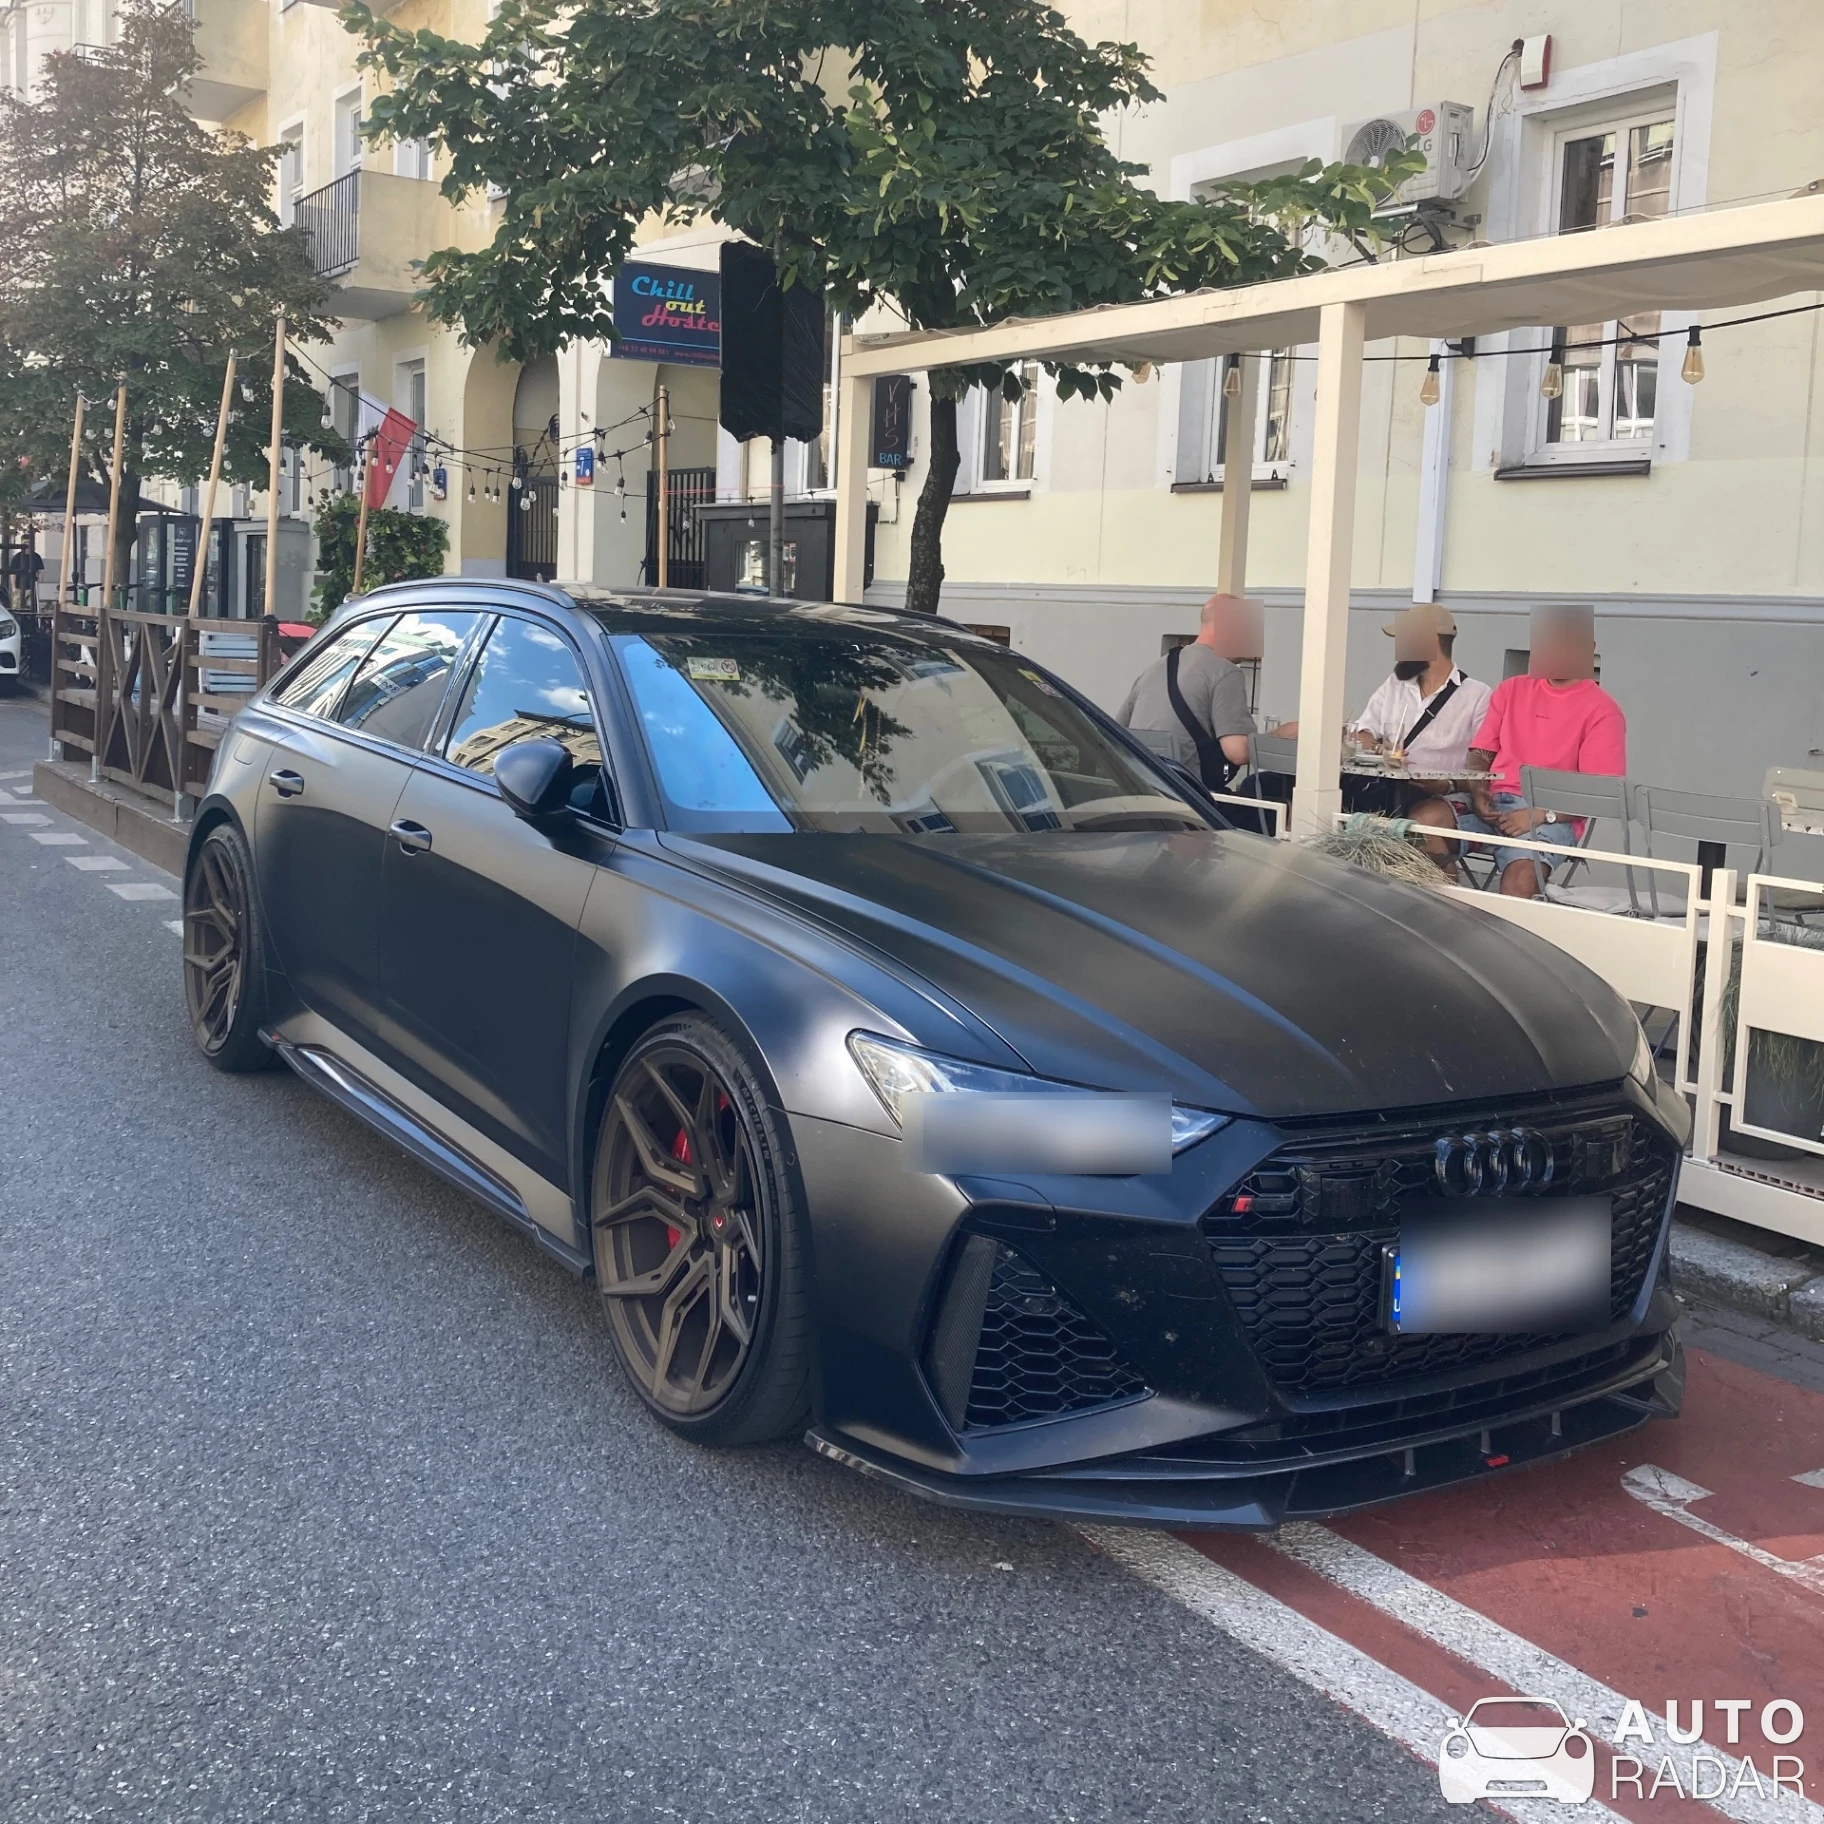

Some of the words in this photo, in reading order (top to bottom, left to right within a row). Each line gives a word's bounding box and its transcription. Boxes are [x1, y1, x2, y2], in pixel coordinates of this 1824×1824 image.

[632, 276, 694, 301] Chill
[641, 304, 720, 332] Hoste
[665, 299, 707, 315] out
[879, 452, 902, 465] BAR
[741, 1086, 771, 1160] MICHELIN
